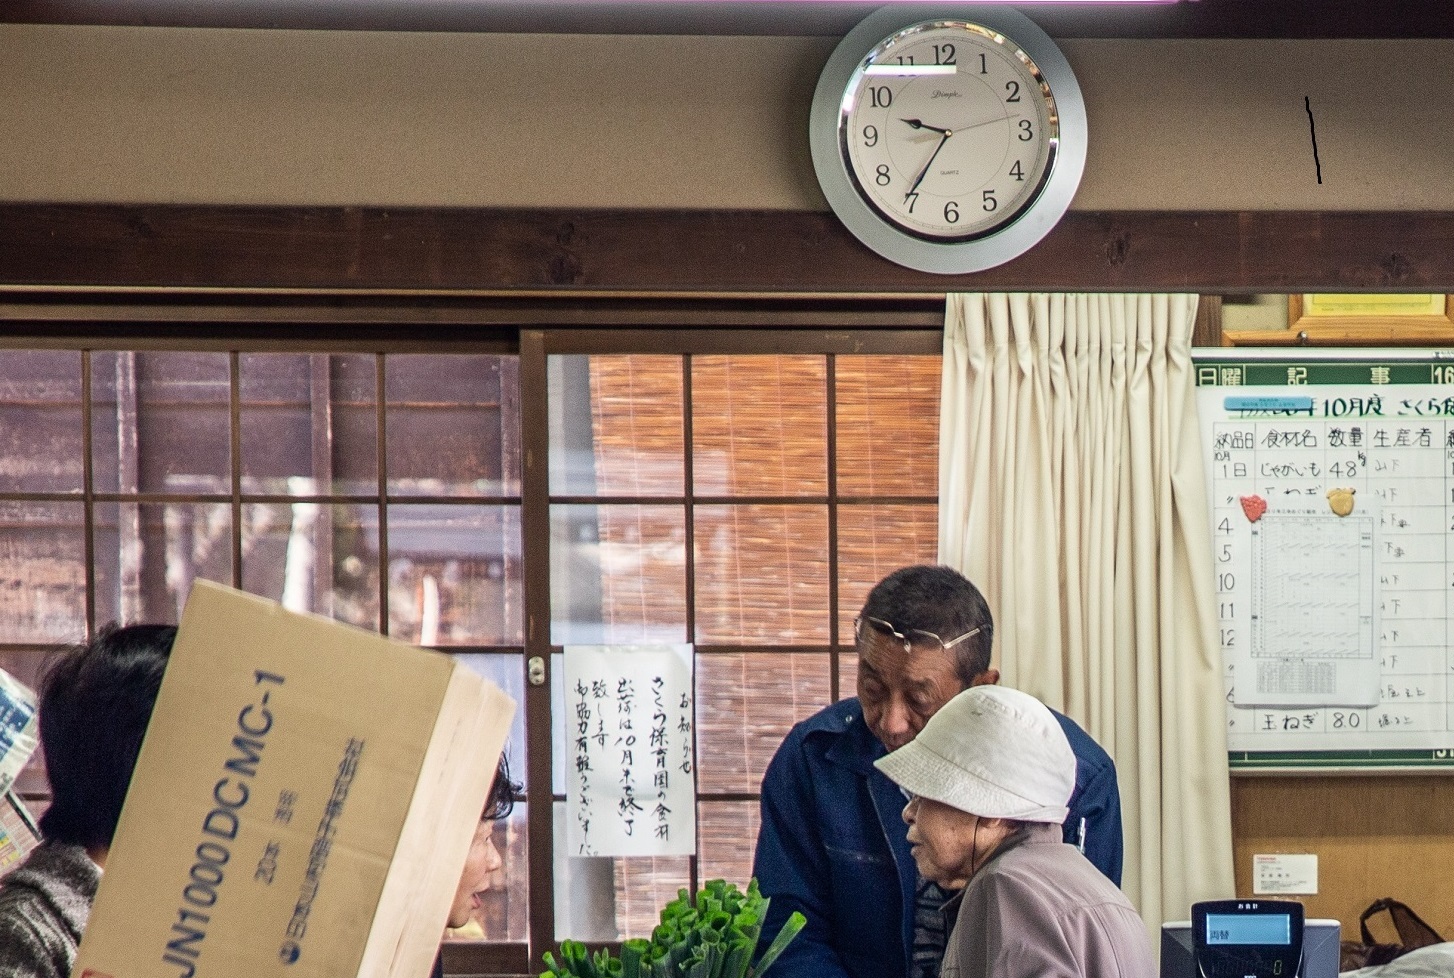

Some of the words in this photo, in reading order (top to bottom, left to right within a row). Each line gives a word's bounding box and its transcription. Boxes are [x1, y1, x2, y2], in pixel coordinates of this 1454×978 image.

[932, 43, 957, 66] 12
[979, 53, 988, 74] 1
[869, 86, 893, 108] 10
[1006, 81, 1020, 102] 2
[863, 125, 878, 147] 9
[1018, 120, 1033, 141] 3
[876, 164, 890, 185] 8
[1009, 160, 1024, 181] 4
[905, 192, 919, 214] 7
[983, 190, 998, 211] 5
[943, 201, 960, 223] 6
[1434, 367, 1454, 385] 16
[1216, 431, 1254, 449] 納品日
[1261, 430, 1317, 449] 食材名
[1329, 427, 1363, 448] 数量
[1374, 429, 1433, 448] 生産者
[1261, 462, 1321, 477] じゃがいも
[1262, 712, 1319, 730] 玉ねぎ
